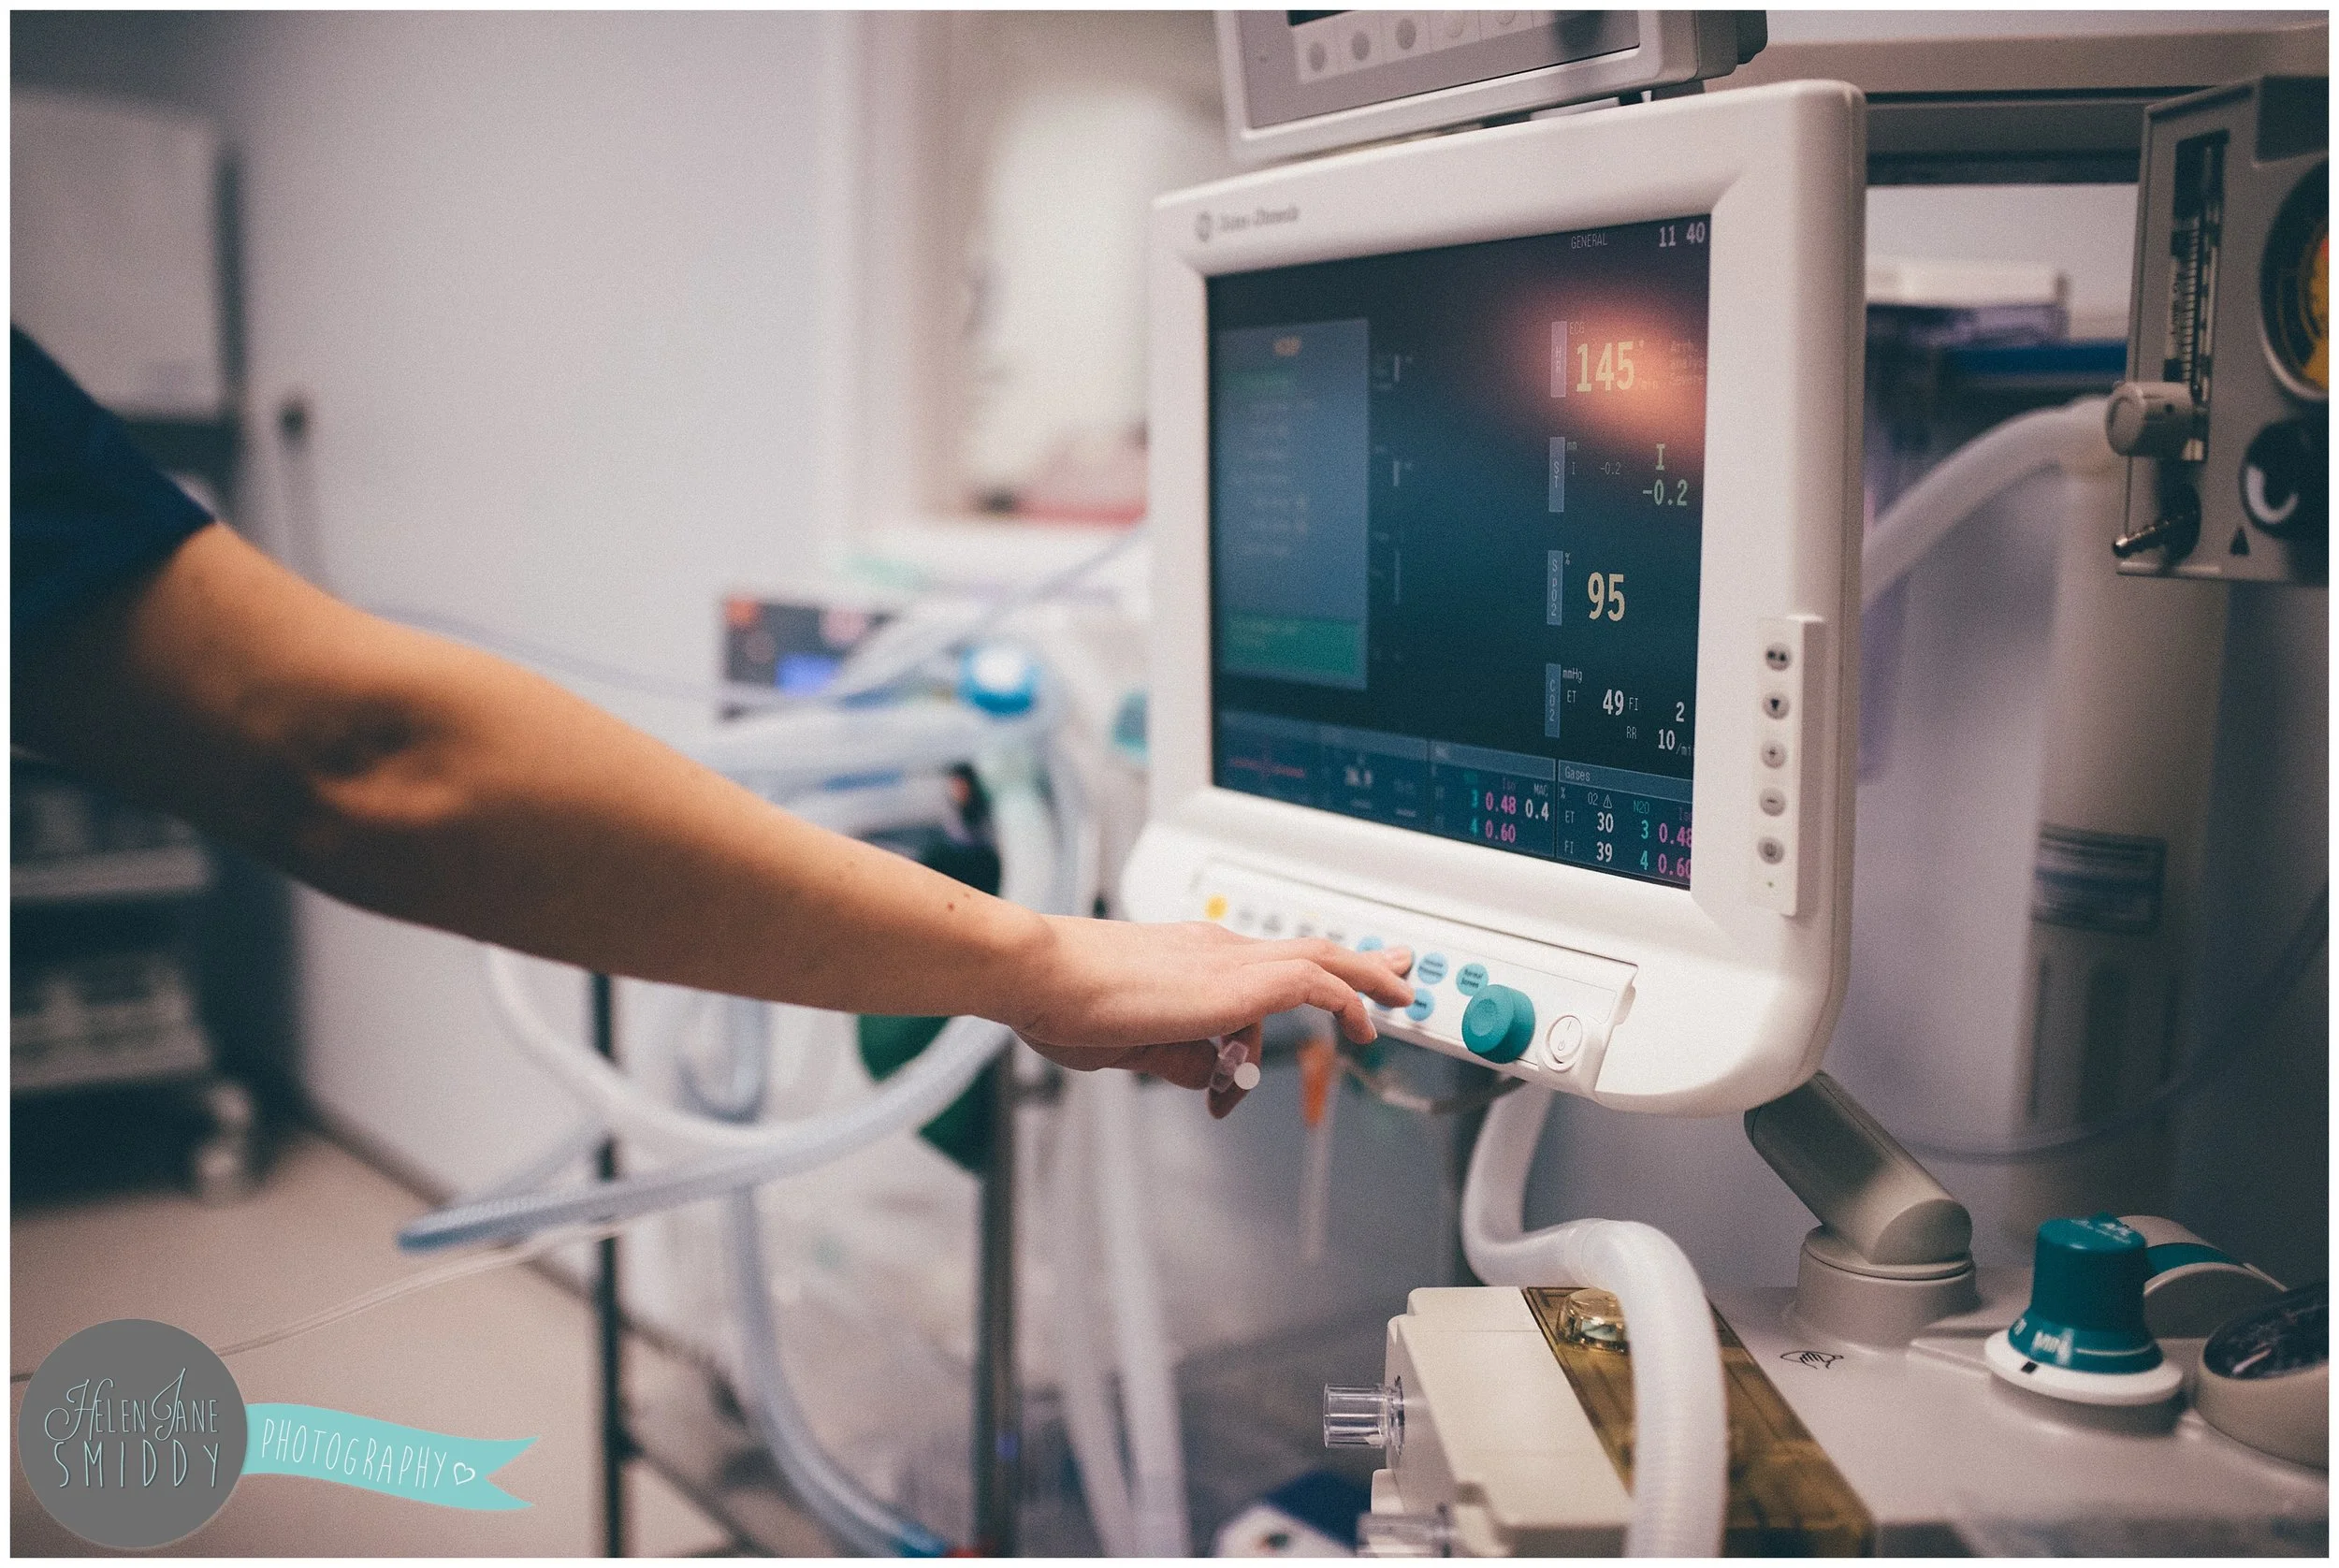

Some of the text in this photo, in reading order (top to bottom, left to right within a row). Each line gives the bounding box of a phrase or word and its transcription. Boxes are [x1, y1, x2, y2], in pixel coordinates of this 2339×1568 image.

[1571, 234, 1608, 249] GENERAL
[1659, 222, 1707, 247] 11 40
[1576, 341, 1635, 393] 145
[1553, 461, 1560, 488] ST
[1600, 461, 1621, 475] -0.2
[1642, 478, 1688, 506] -0.2
[1588, 572, 1625, 621] 95
[1562, 667, 1583, 684] mmHg
[1566, 689, 1685, 722] ET 49 FI 2
[1626, 725, 1637, 740] RR
[1658, 729, 1676, 750] 10
[1564, 765, 1591, 782] Gases
[1485, 791, 1517, 815] 0.48
[1525, 798, 1549, 821] 0.4
[1485, 820, 1517, 843] 0.60
[1564, 810, 1693, 849] ET 30 3 0.48
[1564, 840, 1574, 854] FI
[1596, 841, 1613, 863] 39
[1639, 849, 1649, 870] 4
